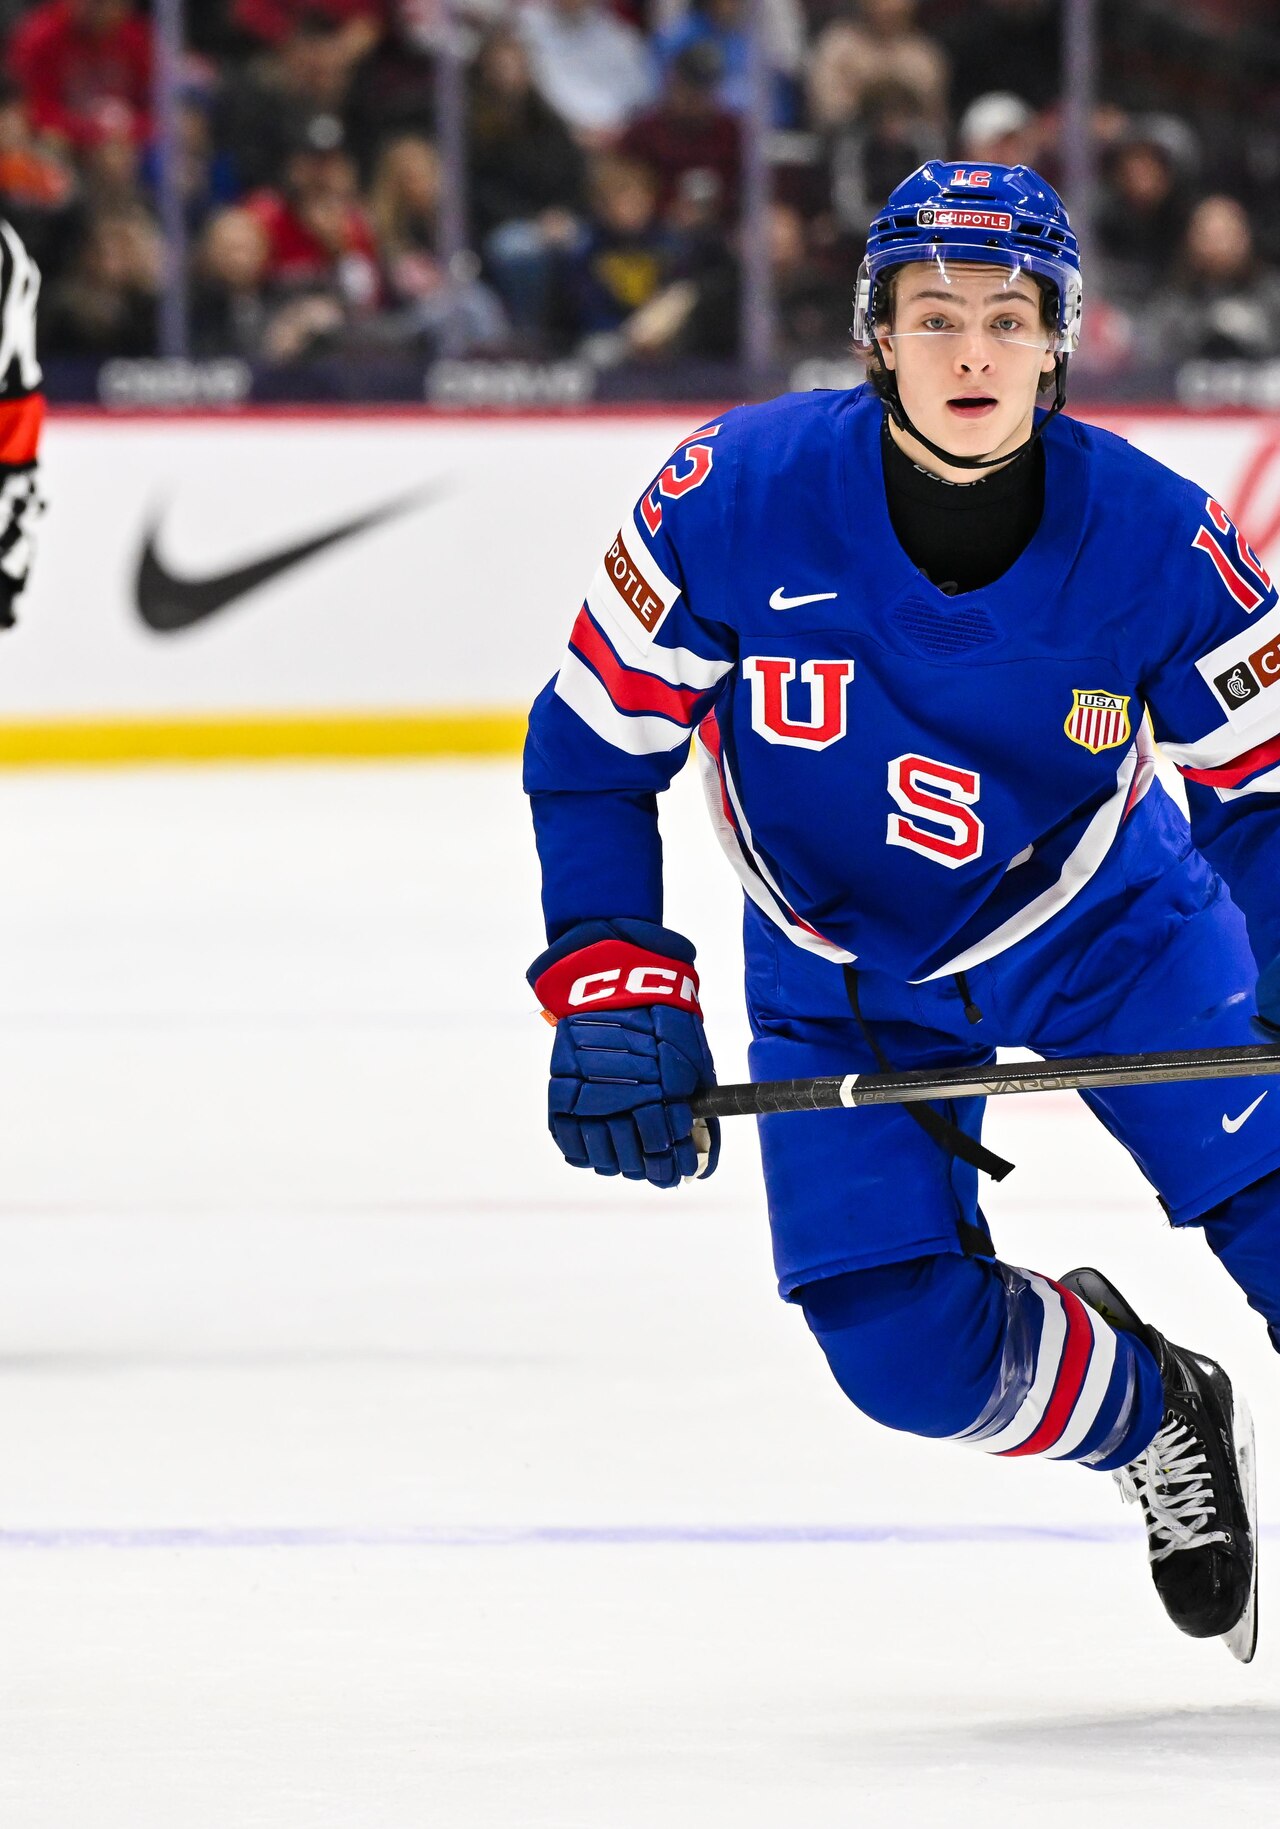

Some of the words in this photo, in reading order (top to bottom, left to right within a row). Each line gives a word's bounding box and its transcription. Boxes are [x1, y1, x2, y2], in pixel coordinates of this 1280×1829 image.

[951, 169, 991, 188] 12
[938, 211, 1007, 228] CHIPOTLE
[1191, 497, 1273, 614] 12
[743, 656, 854, 751] U
[1084, 695, 1117, 708] USA
[886, 752, 984, 869] S
[981, 1076, 1080, 1093] VAPOR
